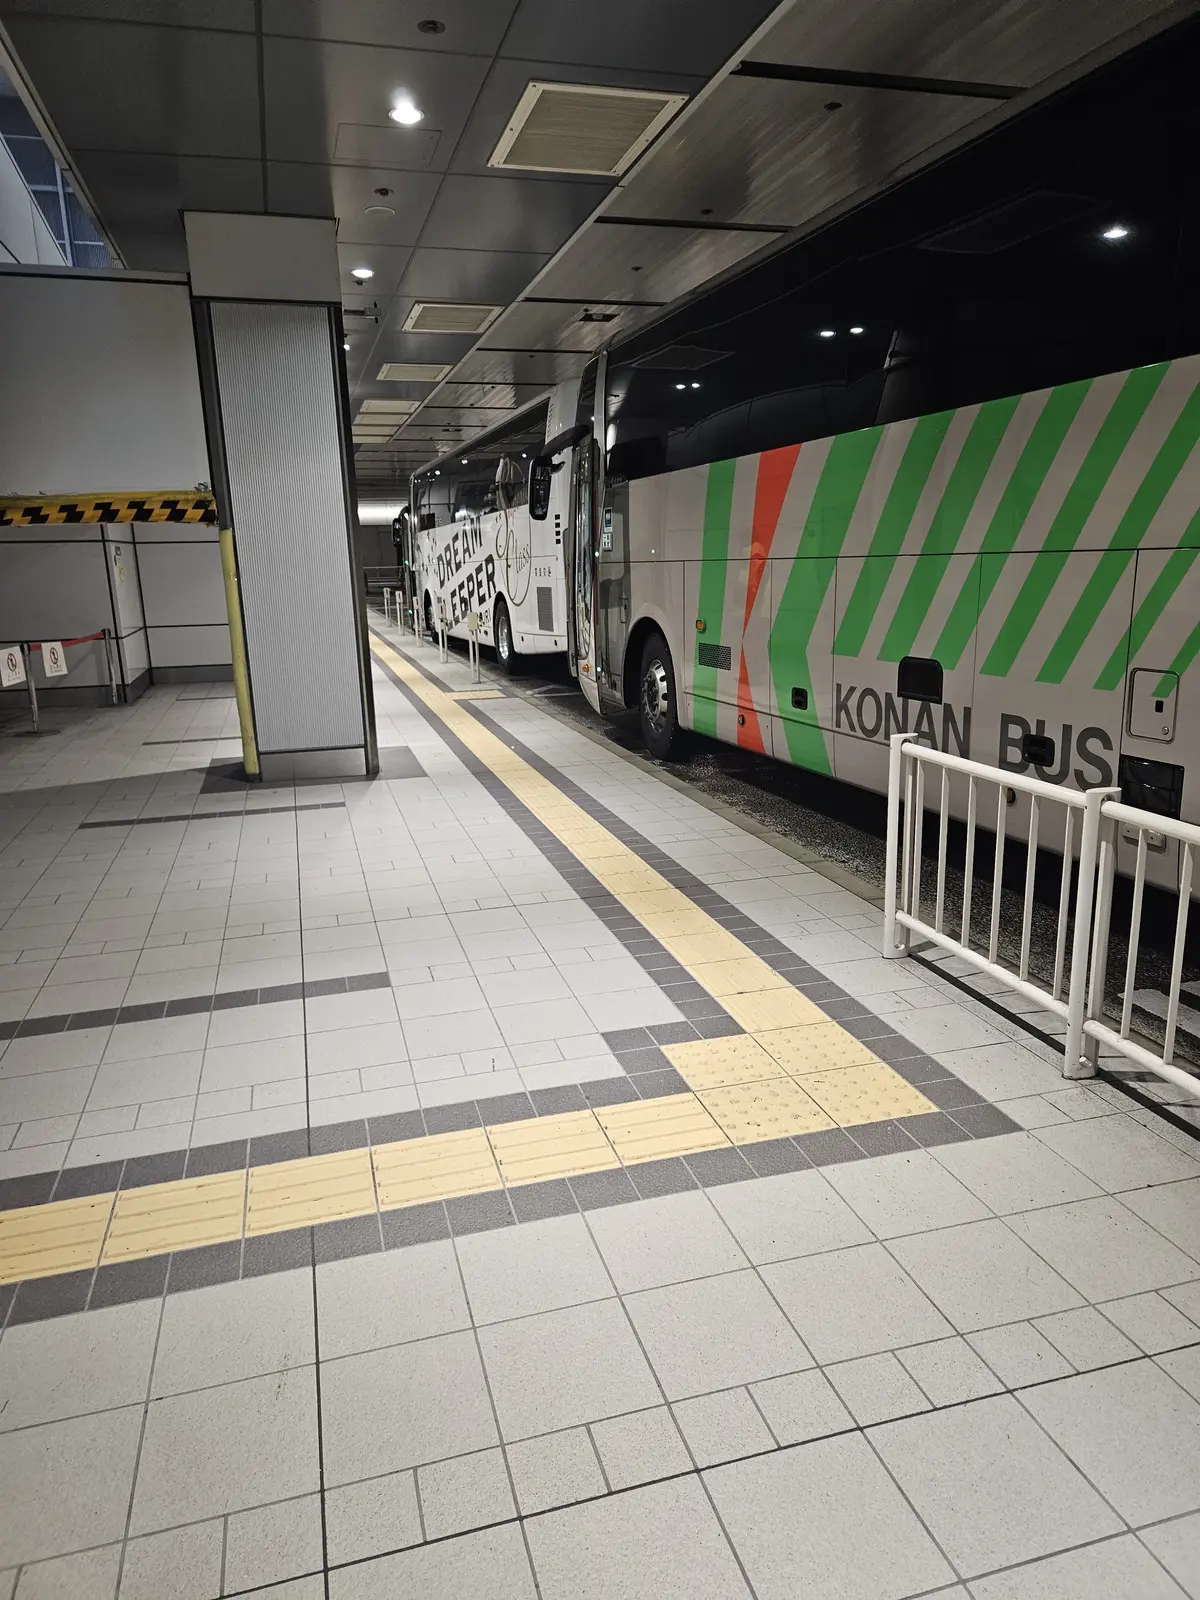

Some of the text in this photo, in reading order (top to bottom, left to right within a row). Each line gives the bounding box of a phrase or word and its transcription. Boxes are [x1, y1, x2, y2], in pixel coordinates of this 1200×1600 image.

[437, 516, 483, 589] DREAM
[835, 683, 1114, 791] KONAN BUS
